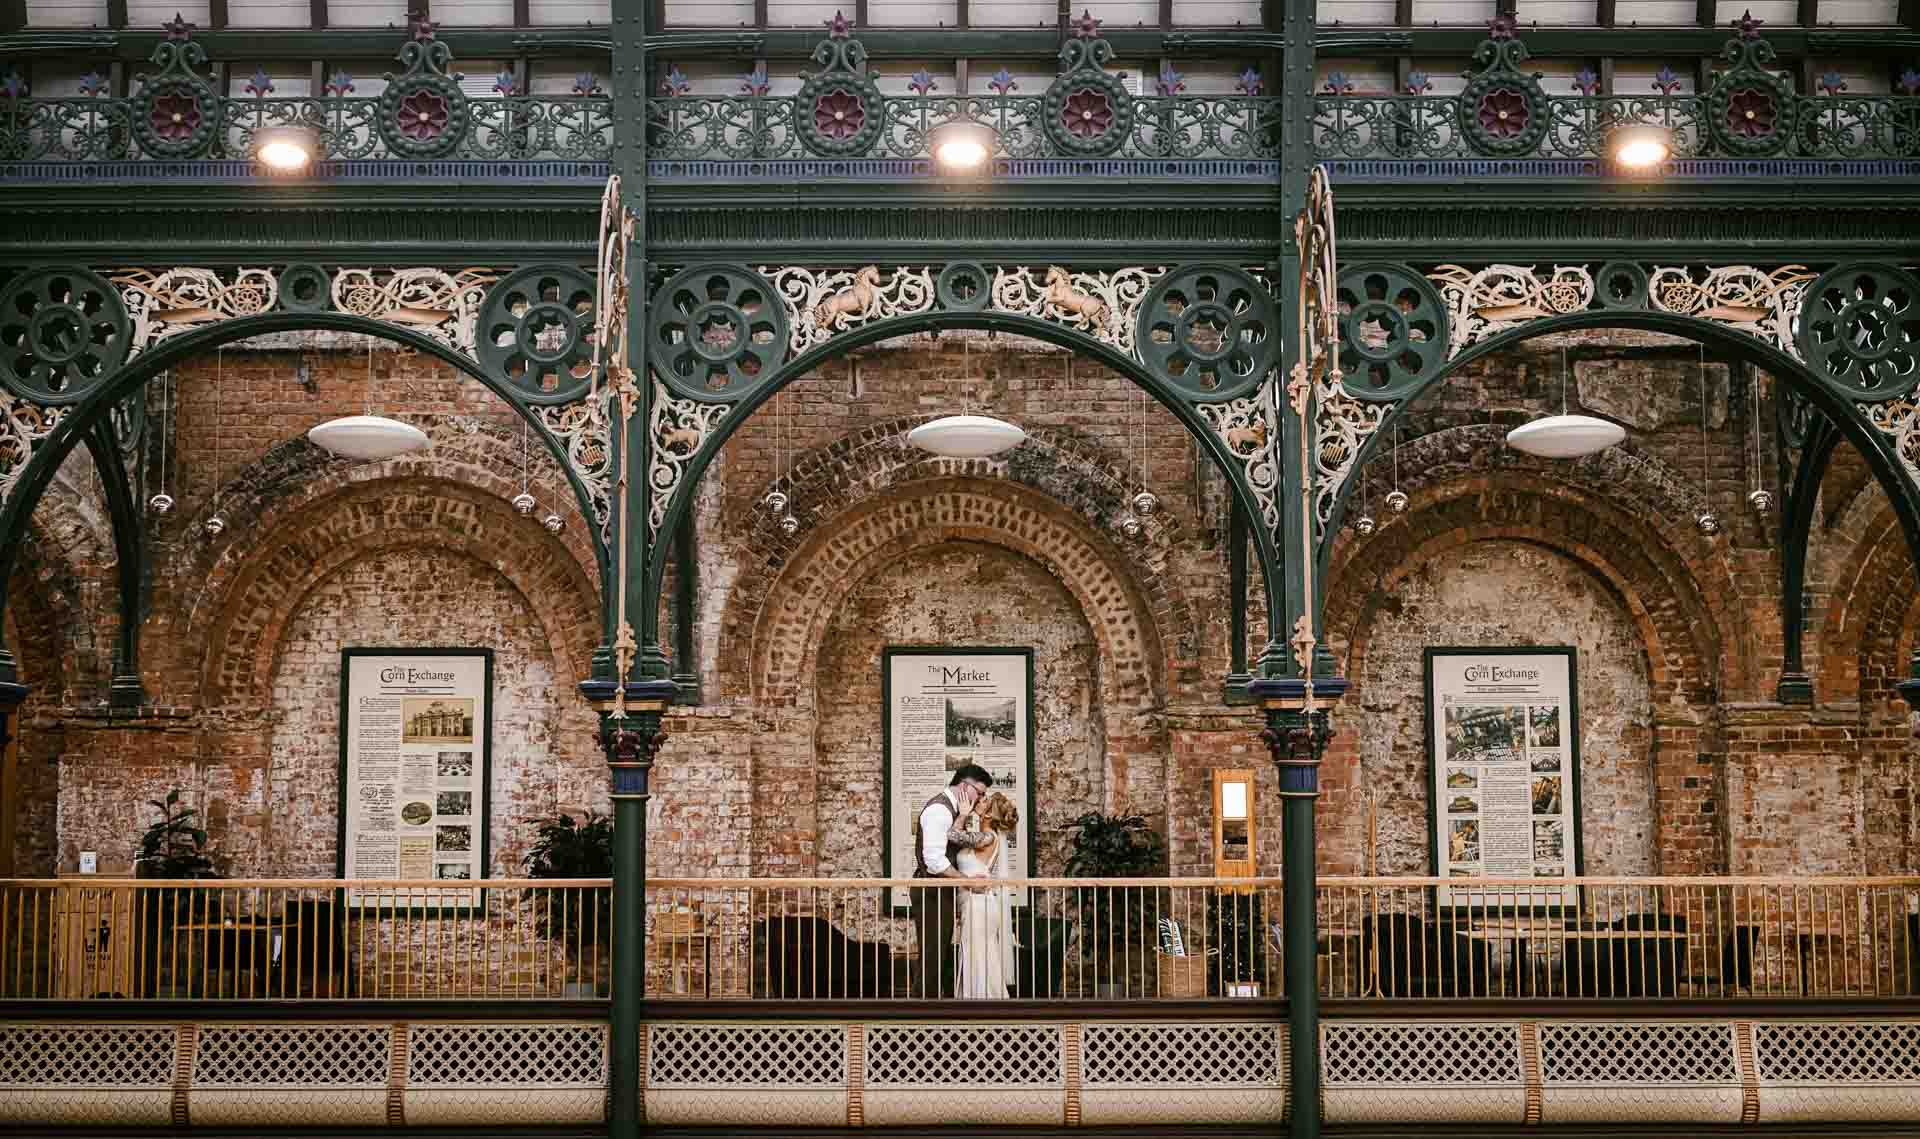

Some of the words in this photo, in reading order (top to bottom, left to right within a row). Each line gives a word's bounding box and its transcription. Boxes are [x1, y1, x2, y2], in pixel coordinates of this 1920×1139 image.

[380, 668, 405, 683] Corn
[408, 668, 455, 683] Exchange
[943, 667, 990, 684] Market
[1464, 666, 1489, 681] Corn
[1491, 666, 1540, 681] Exchange
